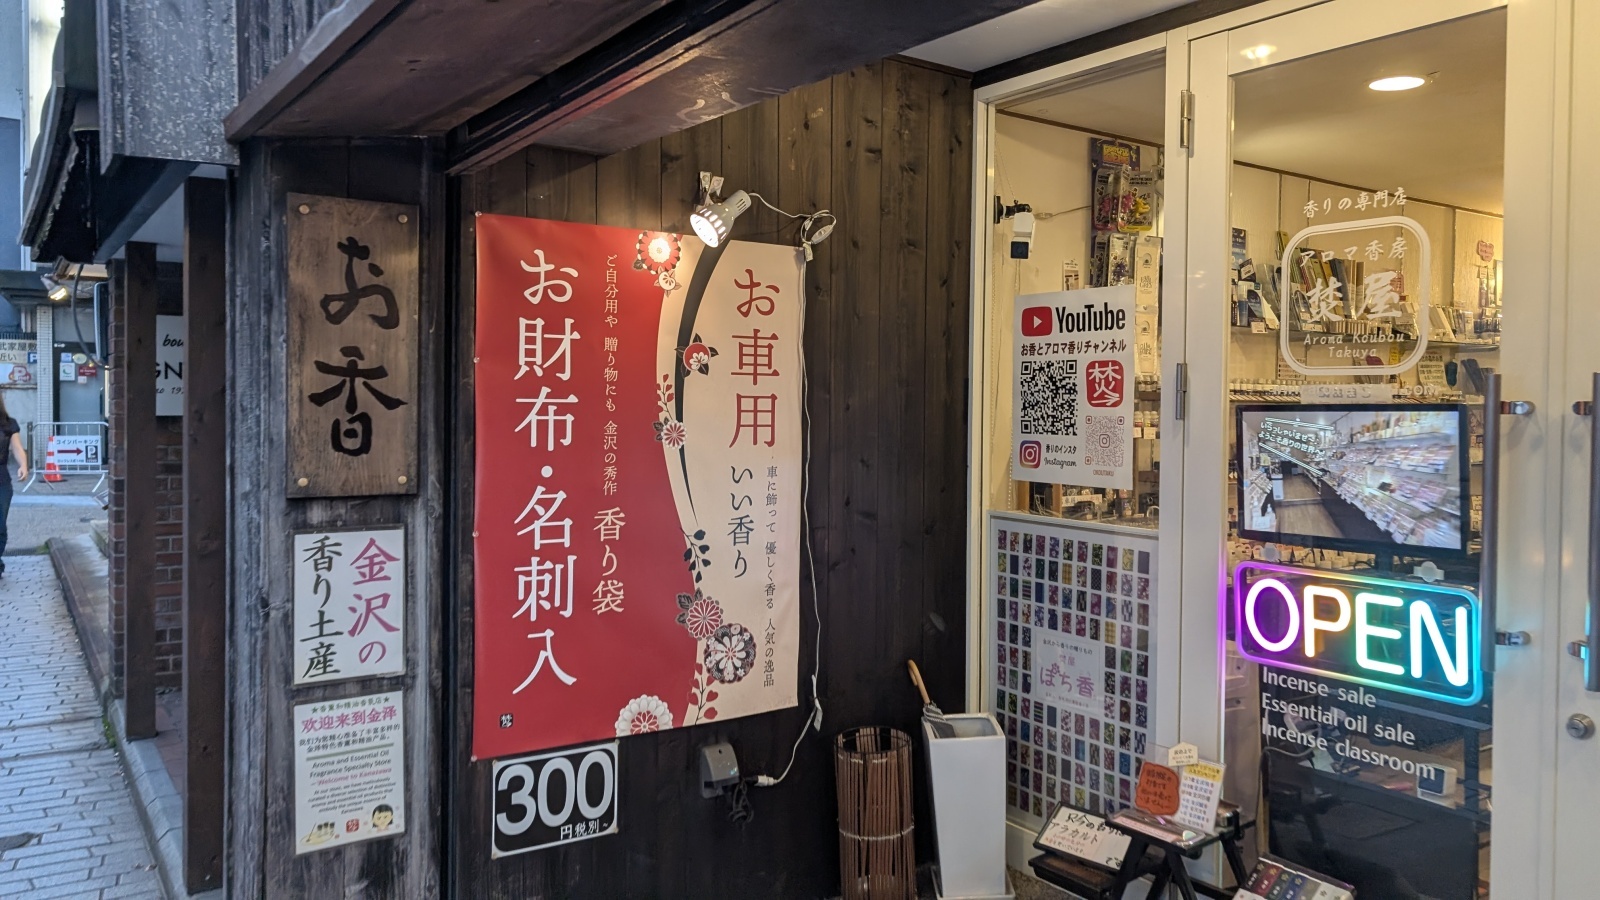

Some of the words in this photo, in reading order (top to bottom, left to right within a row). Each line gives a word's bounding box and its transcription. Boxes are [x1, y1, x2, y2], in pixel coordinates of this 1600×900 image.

[1303, 187, 1408, 218] 香りの専門店
[1300, 237, 1408, 267] アロマ香房
[603, 254, 619, 328] ご自分用や
[1055, 302, 1126, 334] YouTube
[308, 236, 408, 456] お香
[728, 268, 781, 449] お車用
[1021, 339, 1127, 357] お香とアロマ香りチャンネル
[1303, 333, 1344, 345] Aroma
[1352, 331, 1405, 343] Koubou
[1328, 347, 1378, 358] Takuya
[603, 337, 619, 412] 贈り物にも
[512, 248, 581, 695] お財布・名刺入
[602, 420, 618, 496] 金沢の秀作
[1044, 456, 1077, 469] Instagram
[1045, 443, 1077, 454] 香りのインスタ
[727, 465, 755, 579] いい香り
[765, 465, 778, 533] 車に飾って
[592, 506, 626, 615] 香り袋
[764, 541, 777, 610] 優しく香る
[299, 535, 344, 679] 香り土産
[348, 537, 401, 664] 金沢の
[1245, 578, 1469, 687] OPEN
[763, 618, 776, 688] 人気の逸品
[1262, 666, 1329, 697] Incense
[1337, 686, 1377, 708] sale
[301, 705, 397, 734] 欢迎来到金泽
[1262, 692, 1338, 727] Essential
[1344, 714, 1367, 734] oil
[1374, 723, 1416, 746] sale
[1262, 717, 1328, 751] Incense
[1335, 739, 1436, 780] classroom
[310, 767, 342, 778] Fragrance
[344, 762, 373, 773] Specialty
[374, 759, 391, 767] Store
[312, 760, 335, 769] Aroma
[336, 756, 349, 764] and
[350, 751, 379, 762] Essential
[496, 750, 614, 836] 300
